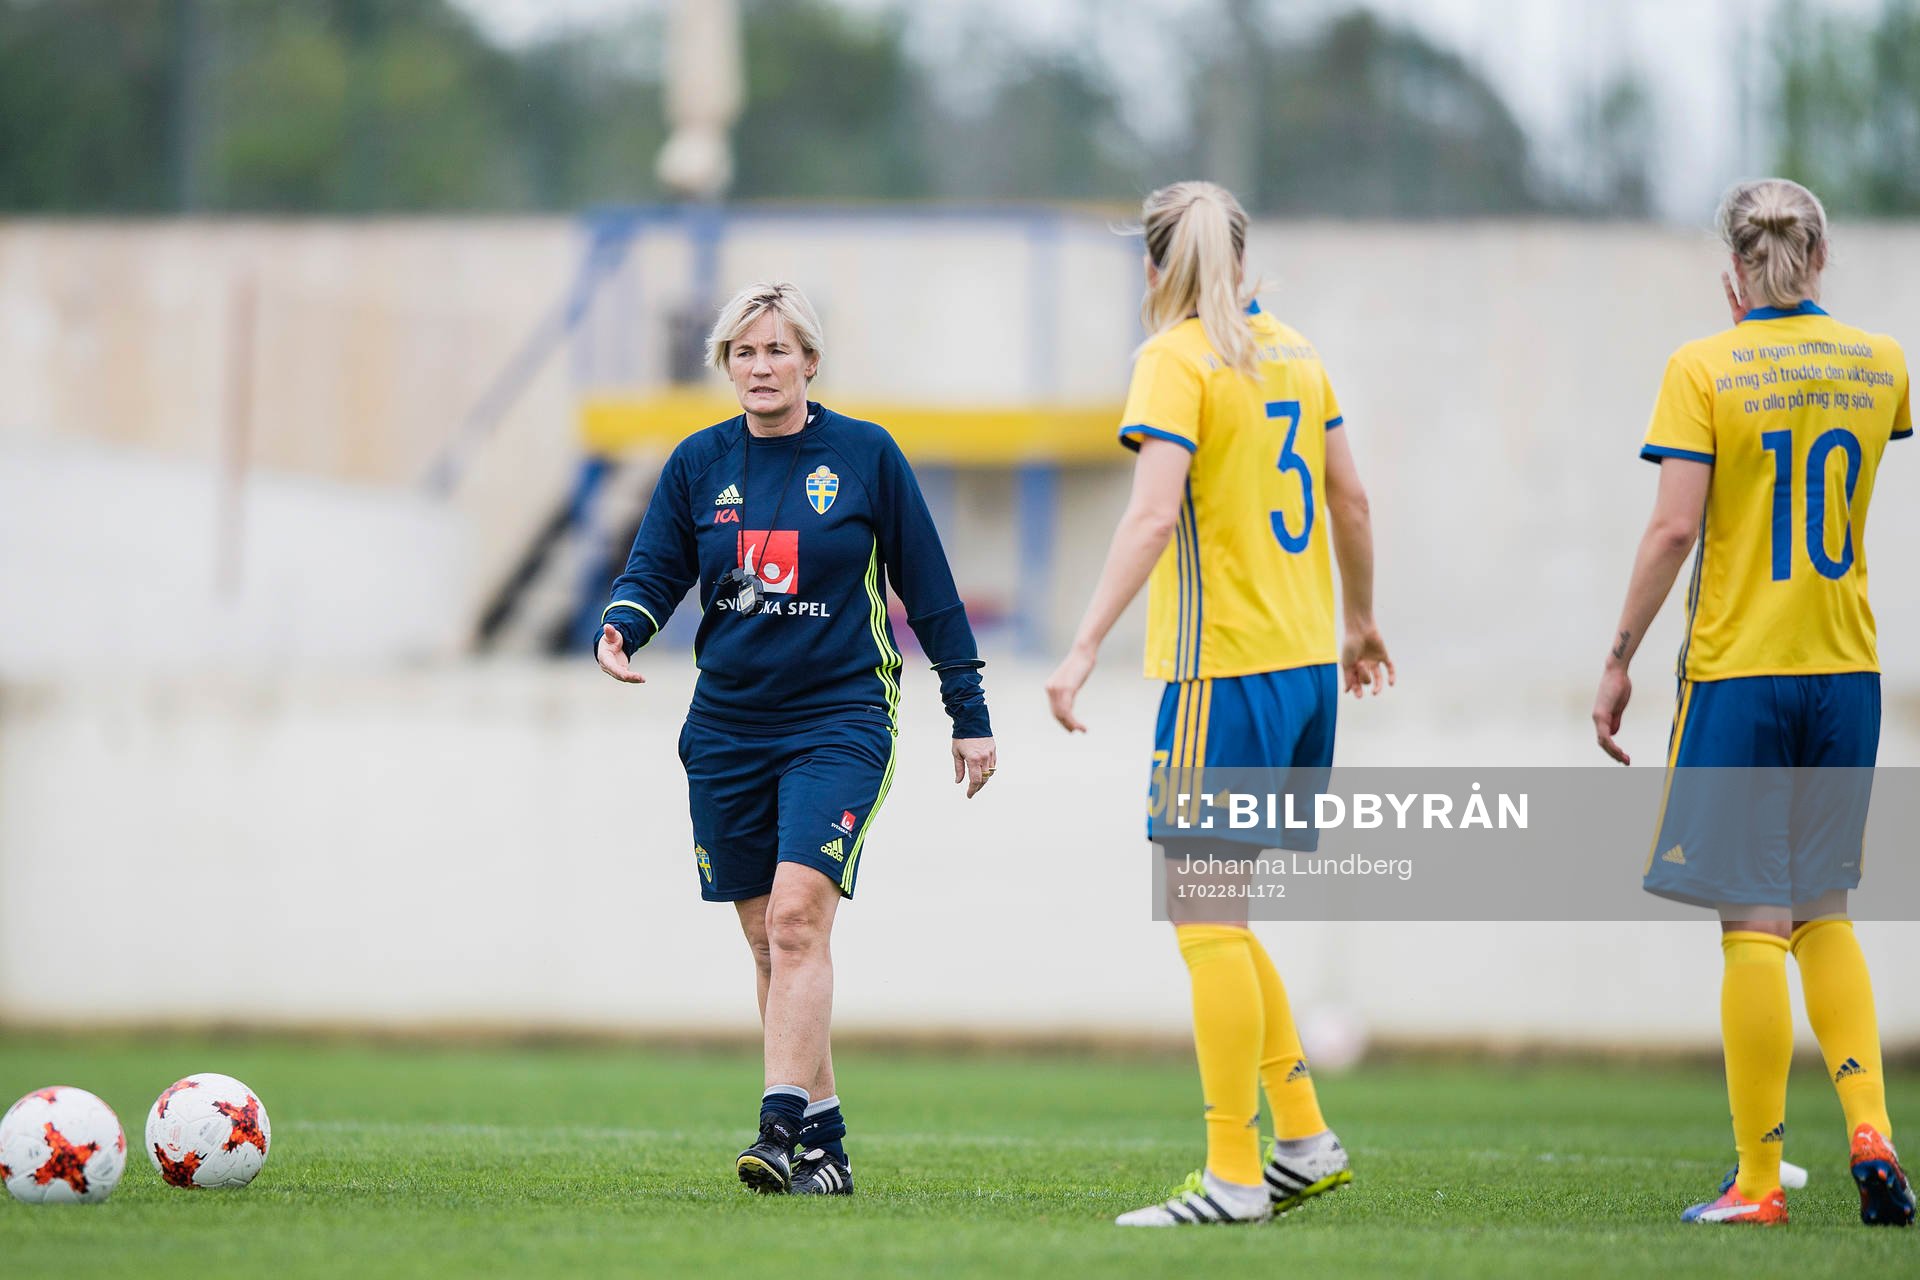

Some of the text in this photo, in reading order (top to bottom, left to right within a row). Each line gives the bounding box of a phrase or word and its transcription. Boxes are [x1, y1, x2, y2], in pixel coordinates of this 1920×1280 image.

[1759, 344, 1796, 361] ingen
[1798, 341, 1837, 355] annan
[1838, 342, 1873, 358] trodde
[1735, 372, 1760, 390] mig
[1762, 365, 1777, 384] så
[1780, 364, 1822, 381] trodde
[1825, 364, 1845, 380] den
[1847, 365, 1895, 387] viktigaste
[1744, 400, 1760, 413] av
[1763, 393, 1785, 410] alla
[1788, 389, 1804, 411] på
[1833, 389, 1849, 410] jag
[1265, 401, 1314, 554] 3
[715, 496, 743, 506] adidas
[1761, 428, 1862, 581] 10
[714, 509, 740, 524] ICA
[716, 598, 831, 617] SVKA SPEL
[1148, 750, 1168, 818] 3
